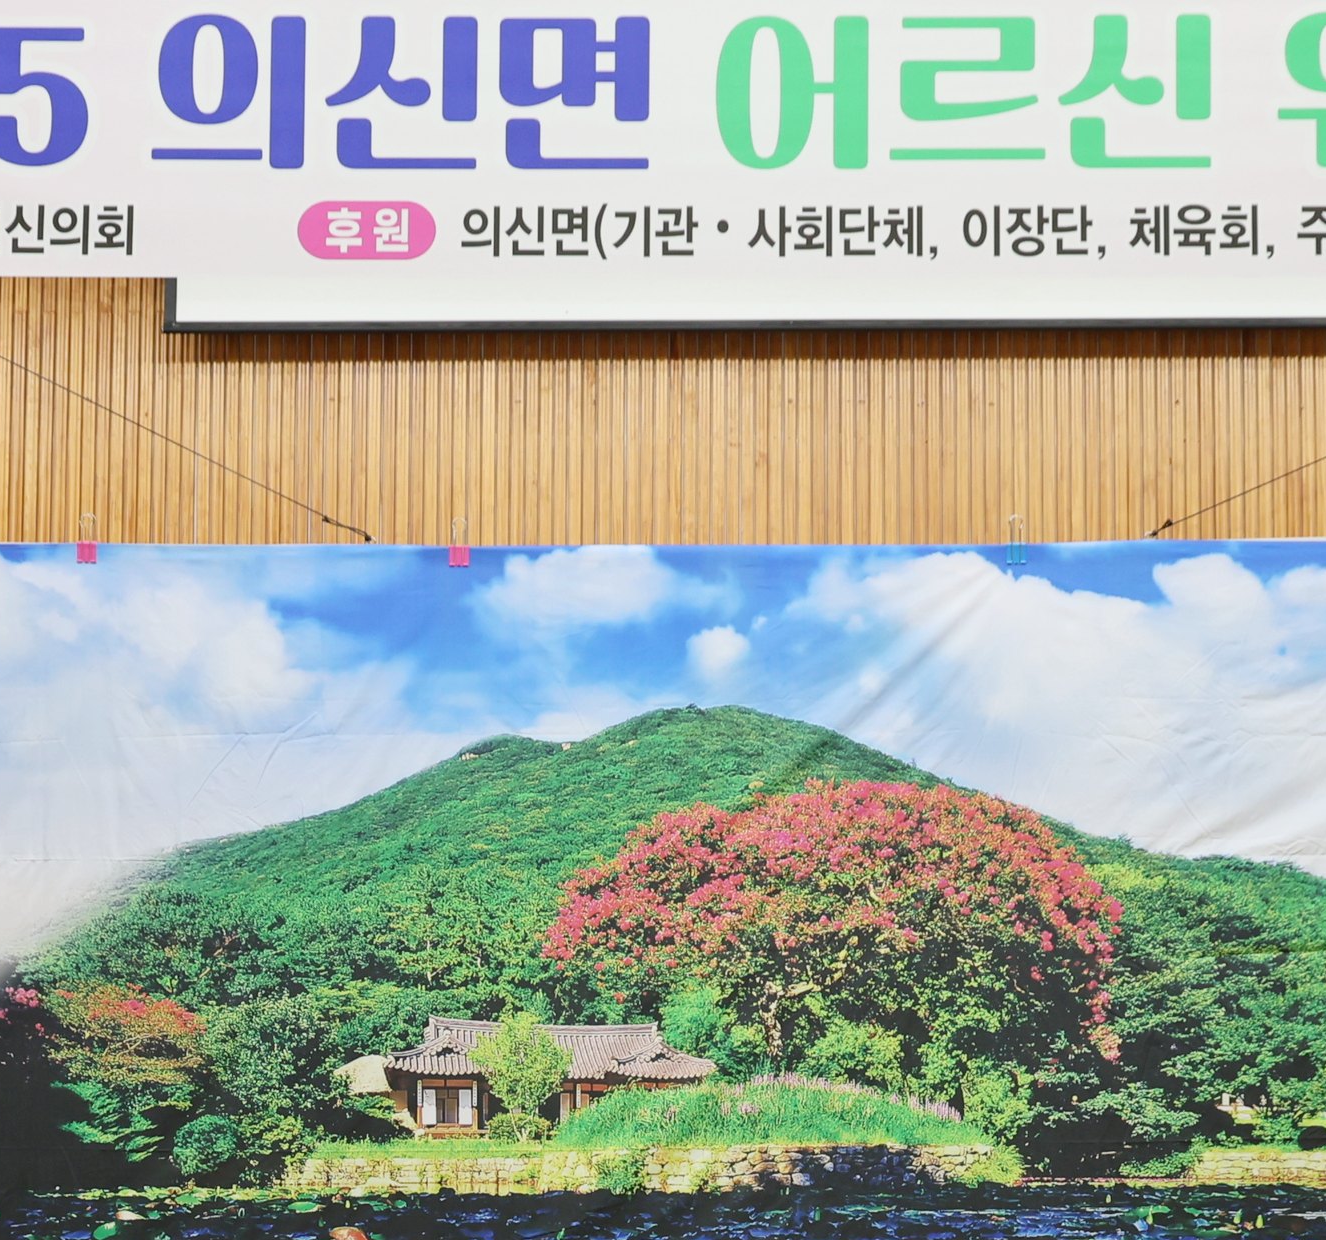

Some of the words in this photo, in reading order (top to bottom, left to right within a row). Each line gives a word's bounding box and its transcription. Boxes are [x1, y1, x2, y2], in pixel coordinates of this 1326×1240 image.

[151, 13, 650, 171] 의신면
[715, 13, 1213, 171] 어르신
[325, 207, 411, 254] 후원
[962, 206, 1108, 259] 이장단,
[1129, 205, 1276, 258] 체육회,
